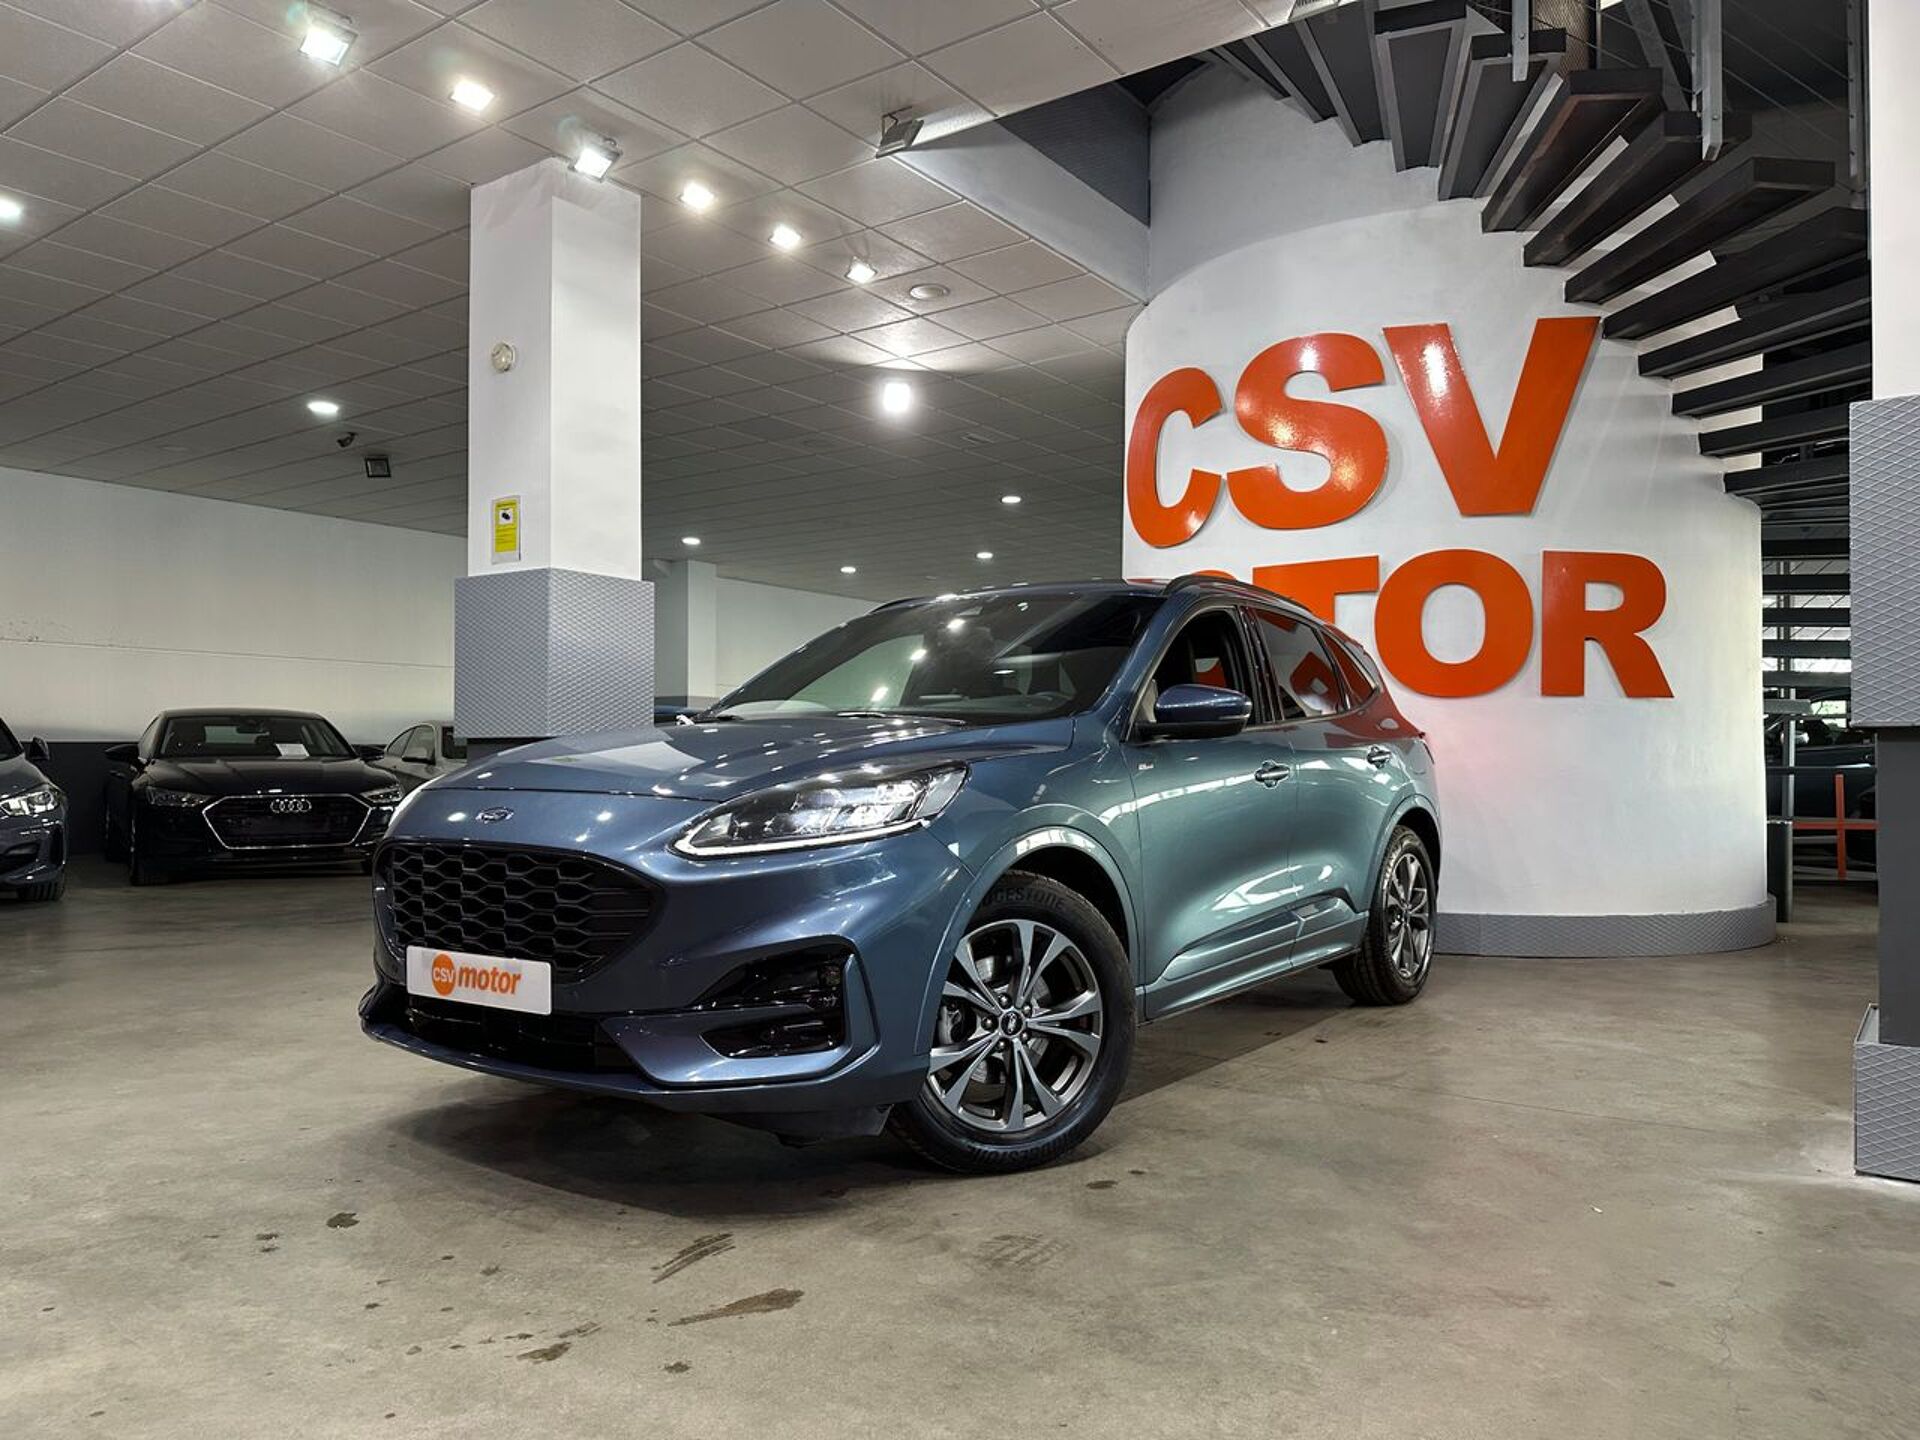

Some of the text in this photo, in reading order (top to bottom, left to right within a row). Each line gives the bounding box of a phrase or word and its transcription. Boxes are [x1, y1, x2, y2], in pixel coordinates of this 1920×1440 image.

[1127, 316, 1601, 549] CSV
[1127, 548, 1674, 698] TOR
[432, 966, 521, 994] CSV motor
